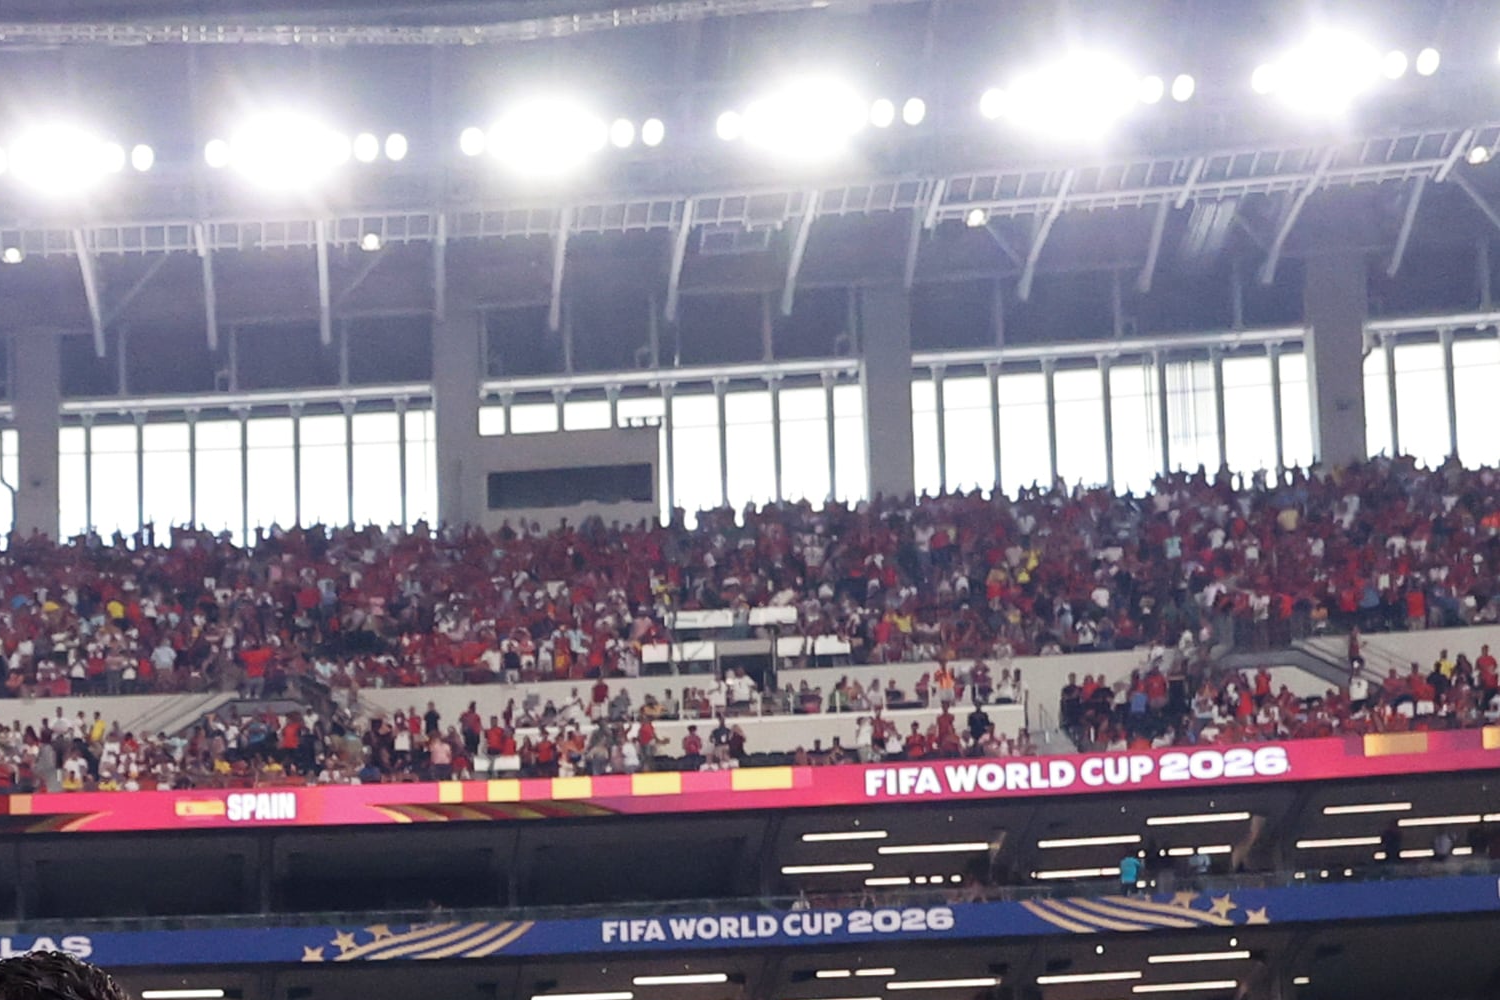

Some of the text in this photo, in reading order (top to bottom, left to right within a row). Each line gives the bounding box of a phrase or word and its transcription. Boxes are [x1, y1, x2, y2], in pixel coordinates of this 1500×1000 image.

[865, 746, 1289, 796] FIFA WORLD CUP 2026
[227, 792, 296, 821] SPAIN
[602, 907, 954, 943] FIFA WORLD CUP 2026
